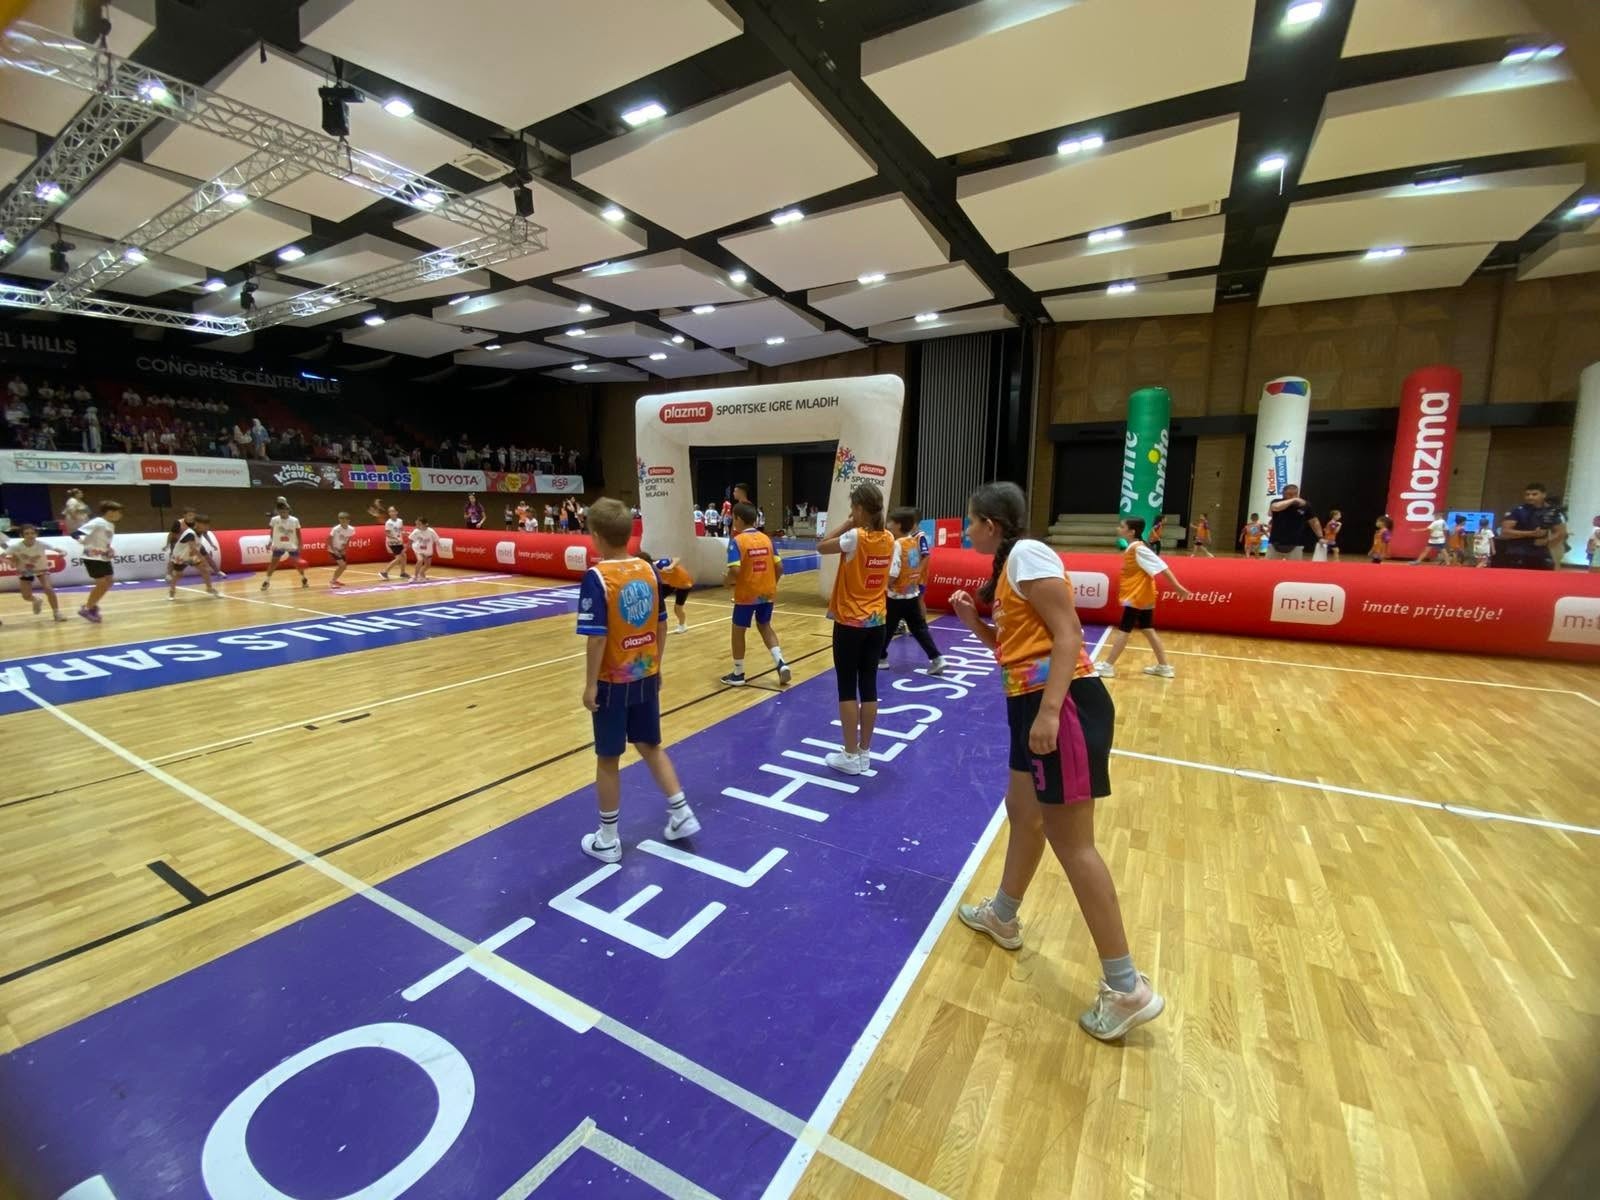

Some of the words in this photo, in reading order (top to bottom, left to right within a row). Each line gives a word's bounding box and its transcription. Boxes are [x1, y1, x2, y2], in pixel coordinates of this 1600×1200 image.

[21, 334, 77, 354] HILLS
[136, 356, 238, 381] CONGRESS
[242, 371, 300, 390] CENTER
[663, 405, 706, 421] plazma
[716, 402, 767, 416] SPORTSKE
[769, 399, 792, 411] IGRE
[795, 396, 840, 410] MLADIH
[15, 459, 116, 472] FOUNDATION
[1400, 392, 1450, 523] plazma
[273, 470, 321, 483] Kravica
[348, 470, 412, 483] mentos
[428, 473, 479, 486] TOYOTA
[139, 553, 166, 563] IGRE
[933, 574, 962, 586] imate
[1073, 583, 1101, 598] :tel
[1280, 595, 1335, 613] m:tel
[1362, 600, 1409, 615] imate
[1412, 604, 1504, 622] prijatelje!
[217, 616, 402, 651] HILLS
[624, 633, 652, 649] plazma
